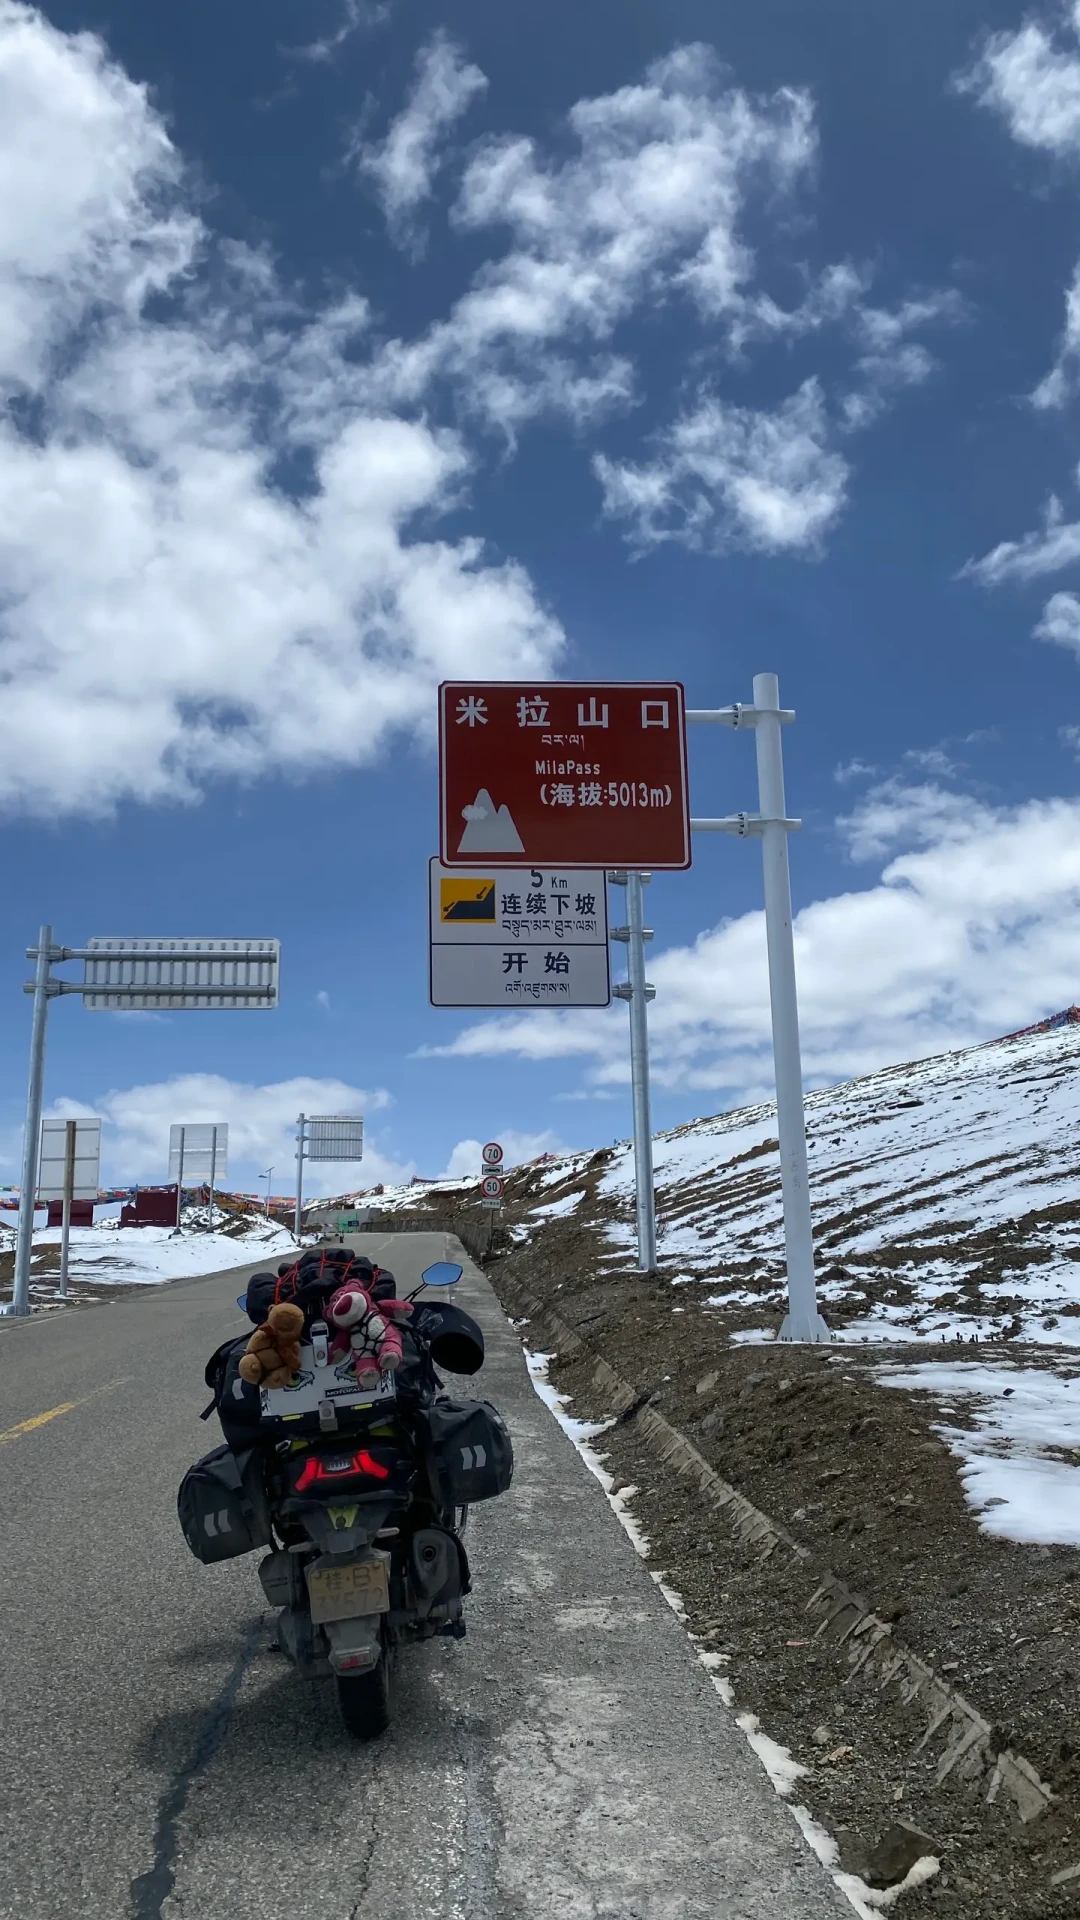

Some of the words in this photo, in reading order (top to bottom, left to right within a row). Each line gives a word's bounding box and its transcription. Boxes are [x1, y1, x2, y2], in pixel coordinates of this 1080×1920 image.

[455, 695, 670, 729] 米拉山口
[535, 760, 601, 775] MilaPass
[531, 869, 544, 888] 5
[551, 877, 568, 889] Km
[501, 893, 596, 916] 连续下坡
[502, 951, 571, 974] 开始
[488, 1149, 498, 1159] 70
[487, 1182, 497, 1192] 50
